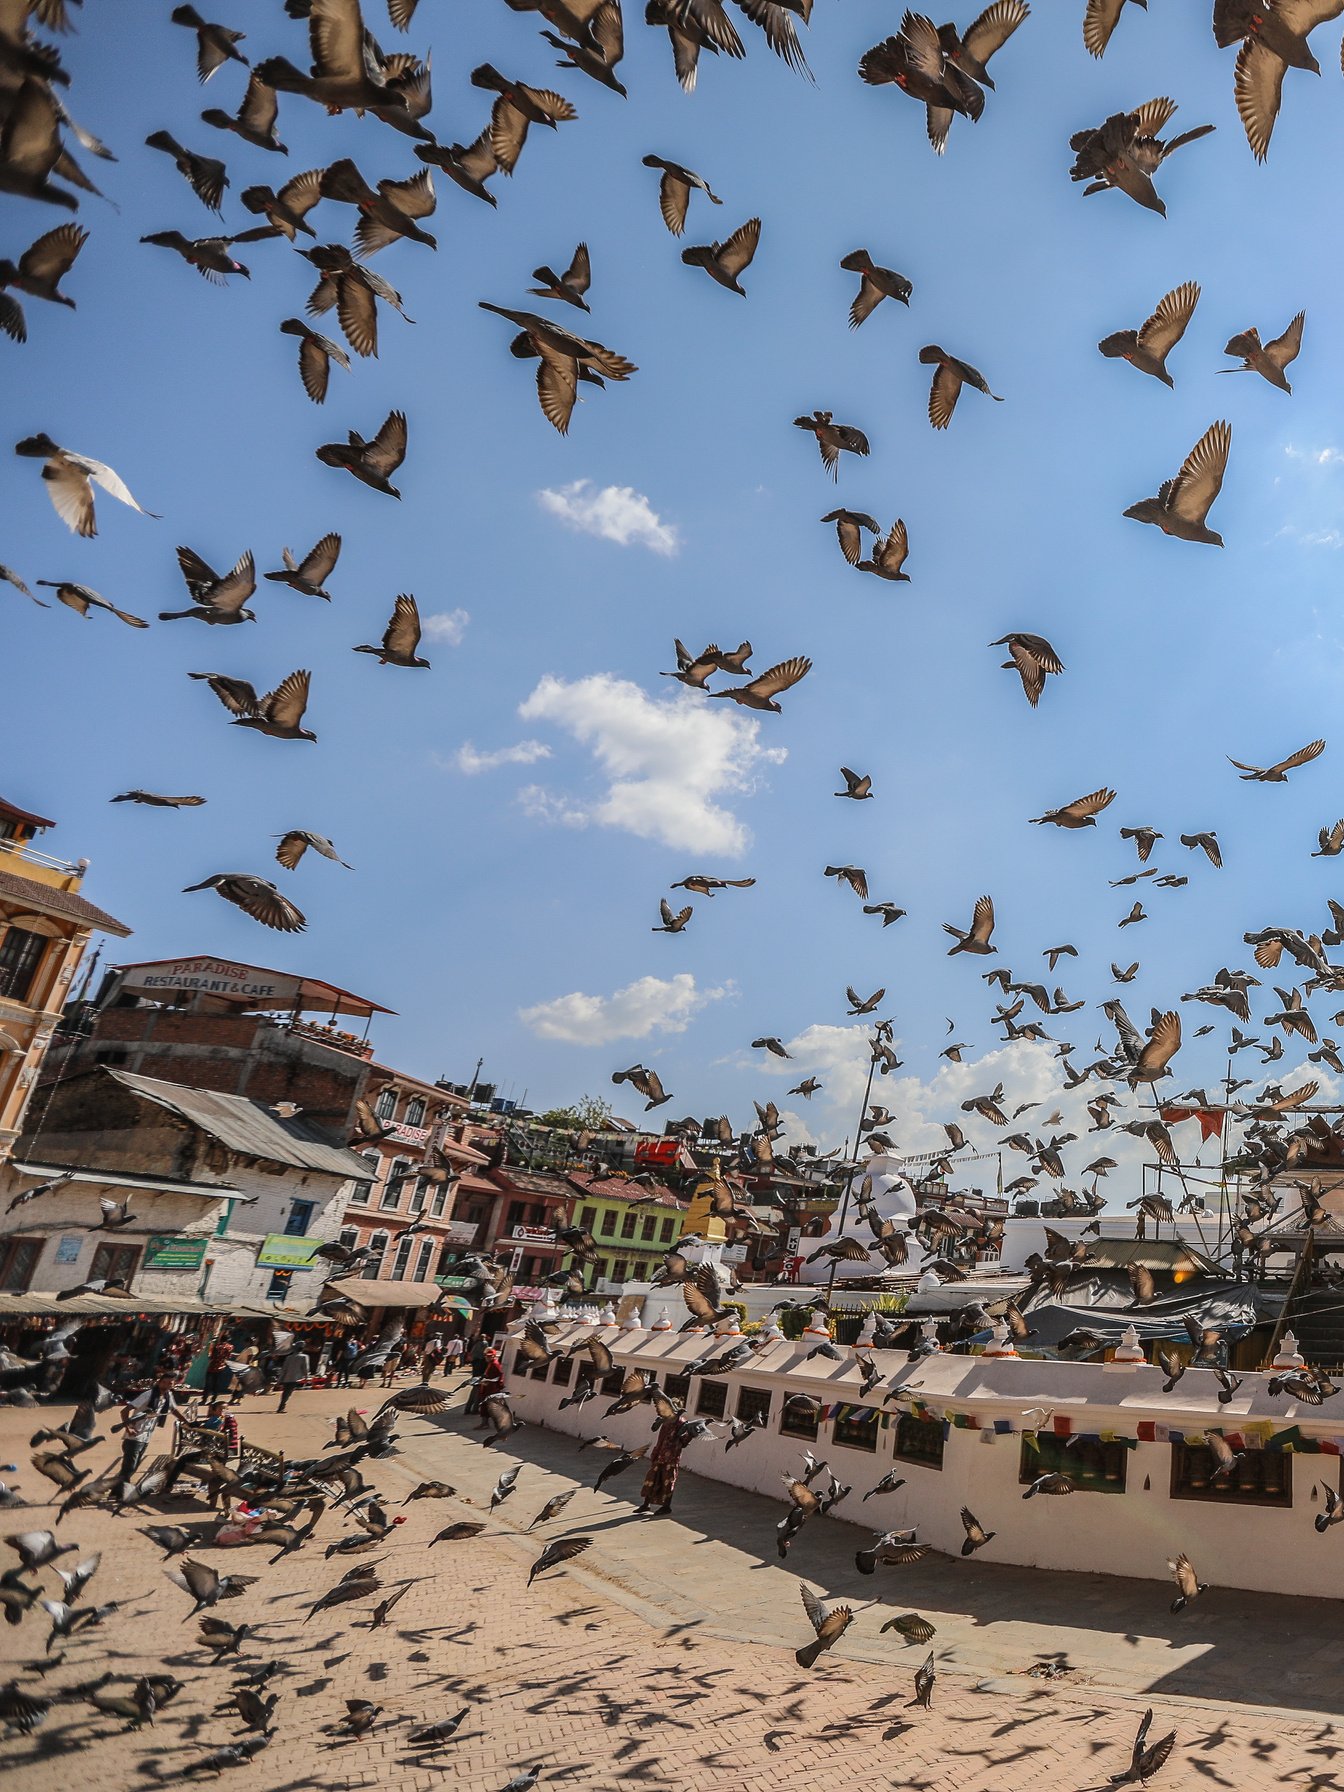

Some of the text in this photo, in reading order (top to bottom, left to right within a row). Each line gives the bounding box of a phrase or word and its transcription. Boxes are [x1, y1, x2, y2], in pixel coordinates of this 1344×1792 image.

[171, 962, 249, 980] PARADISE
[144, 976, 276, 996] RESTAURANT & CAFE
[384, 1121, 427, 1141] PRADISE
